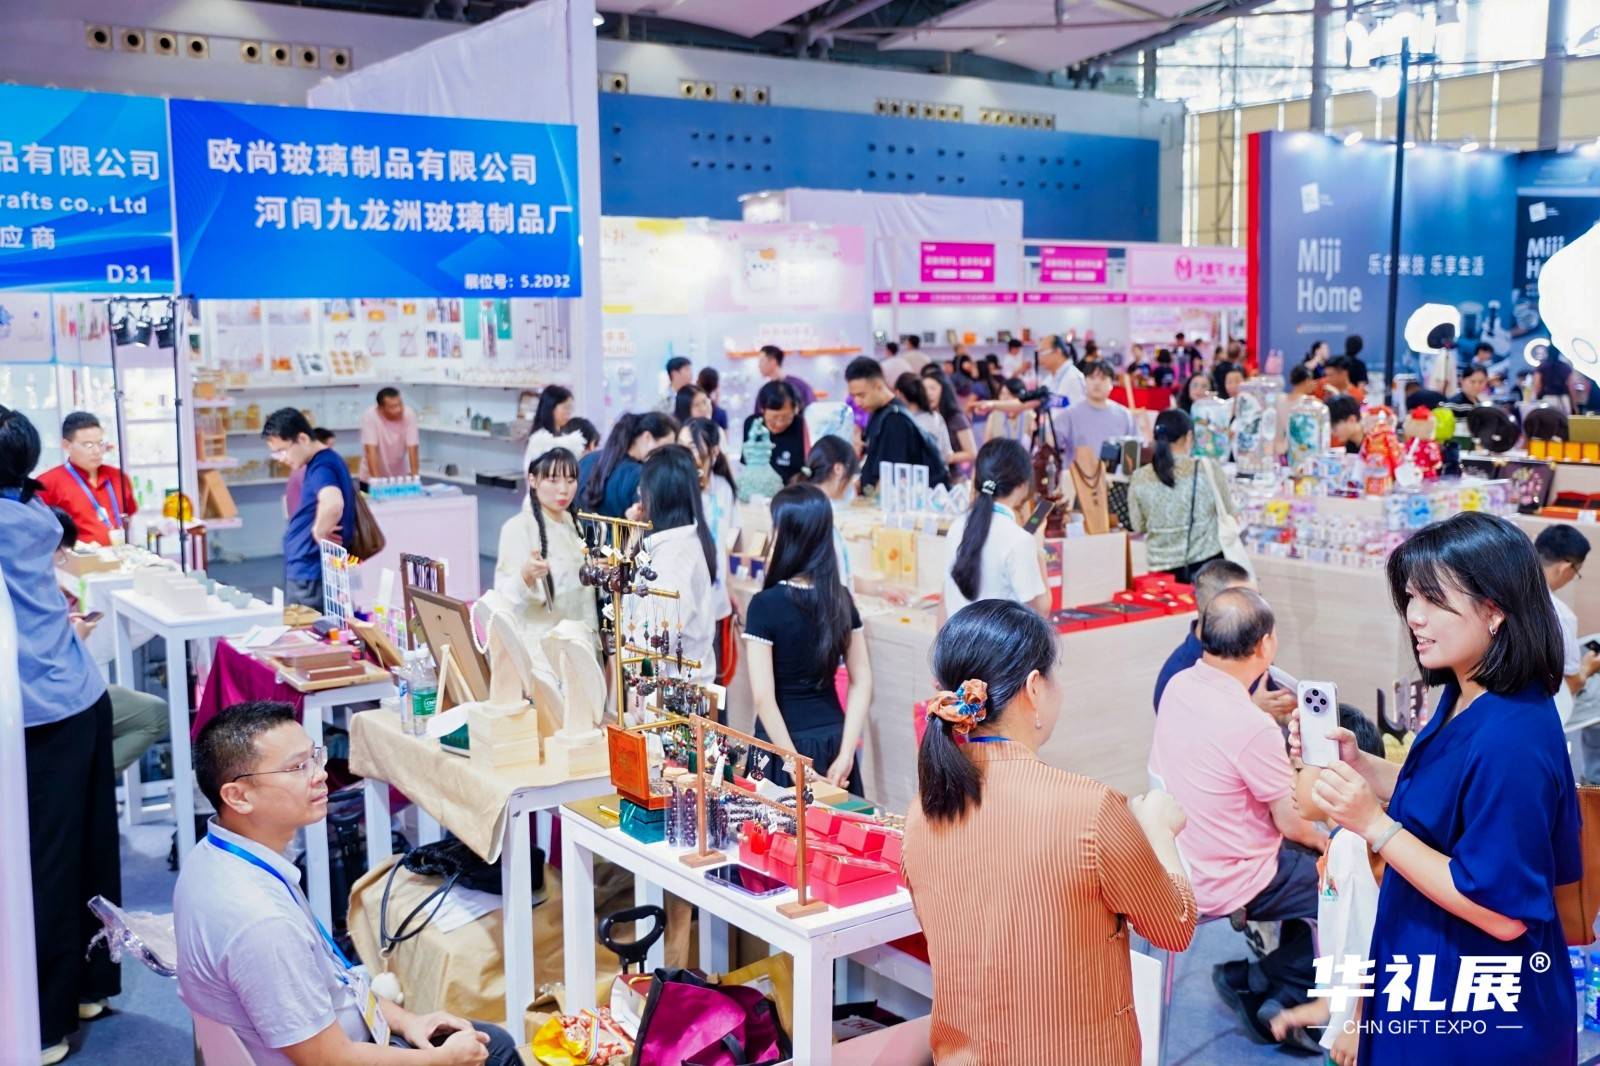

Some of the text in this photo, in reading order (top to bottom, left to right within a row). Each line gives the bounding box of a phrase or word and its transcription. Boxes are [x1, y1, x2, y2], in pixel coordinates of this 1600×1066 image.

[0, 141, 159, 180] 品有限公司
[207, 138, 537, 185] 欧尚玻璃制品有限公司
[60, 197, 104, 215] co.,
[109, 195, 147, 214] Ltd
[255, 196, 573, 234] 河间九龙洲玻璃制品厂
[107, 264, 151, 284] D31
[1298, 237, 1342, 282] Miji
[521, 274, 571, 288] 5.2D32
[1296, 277, 1363, 313] Home
